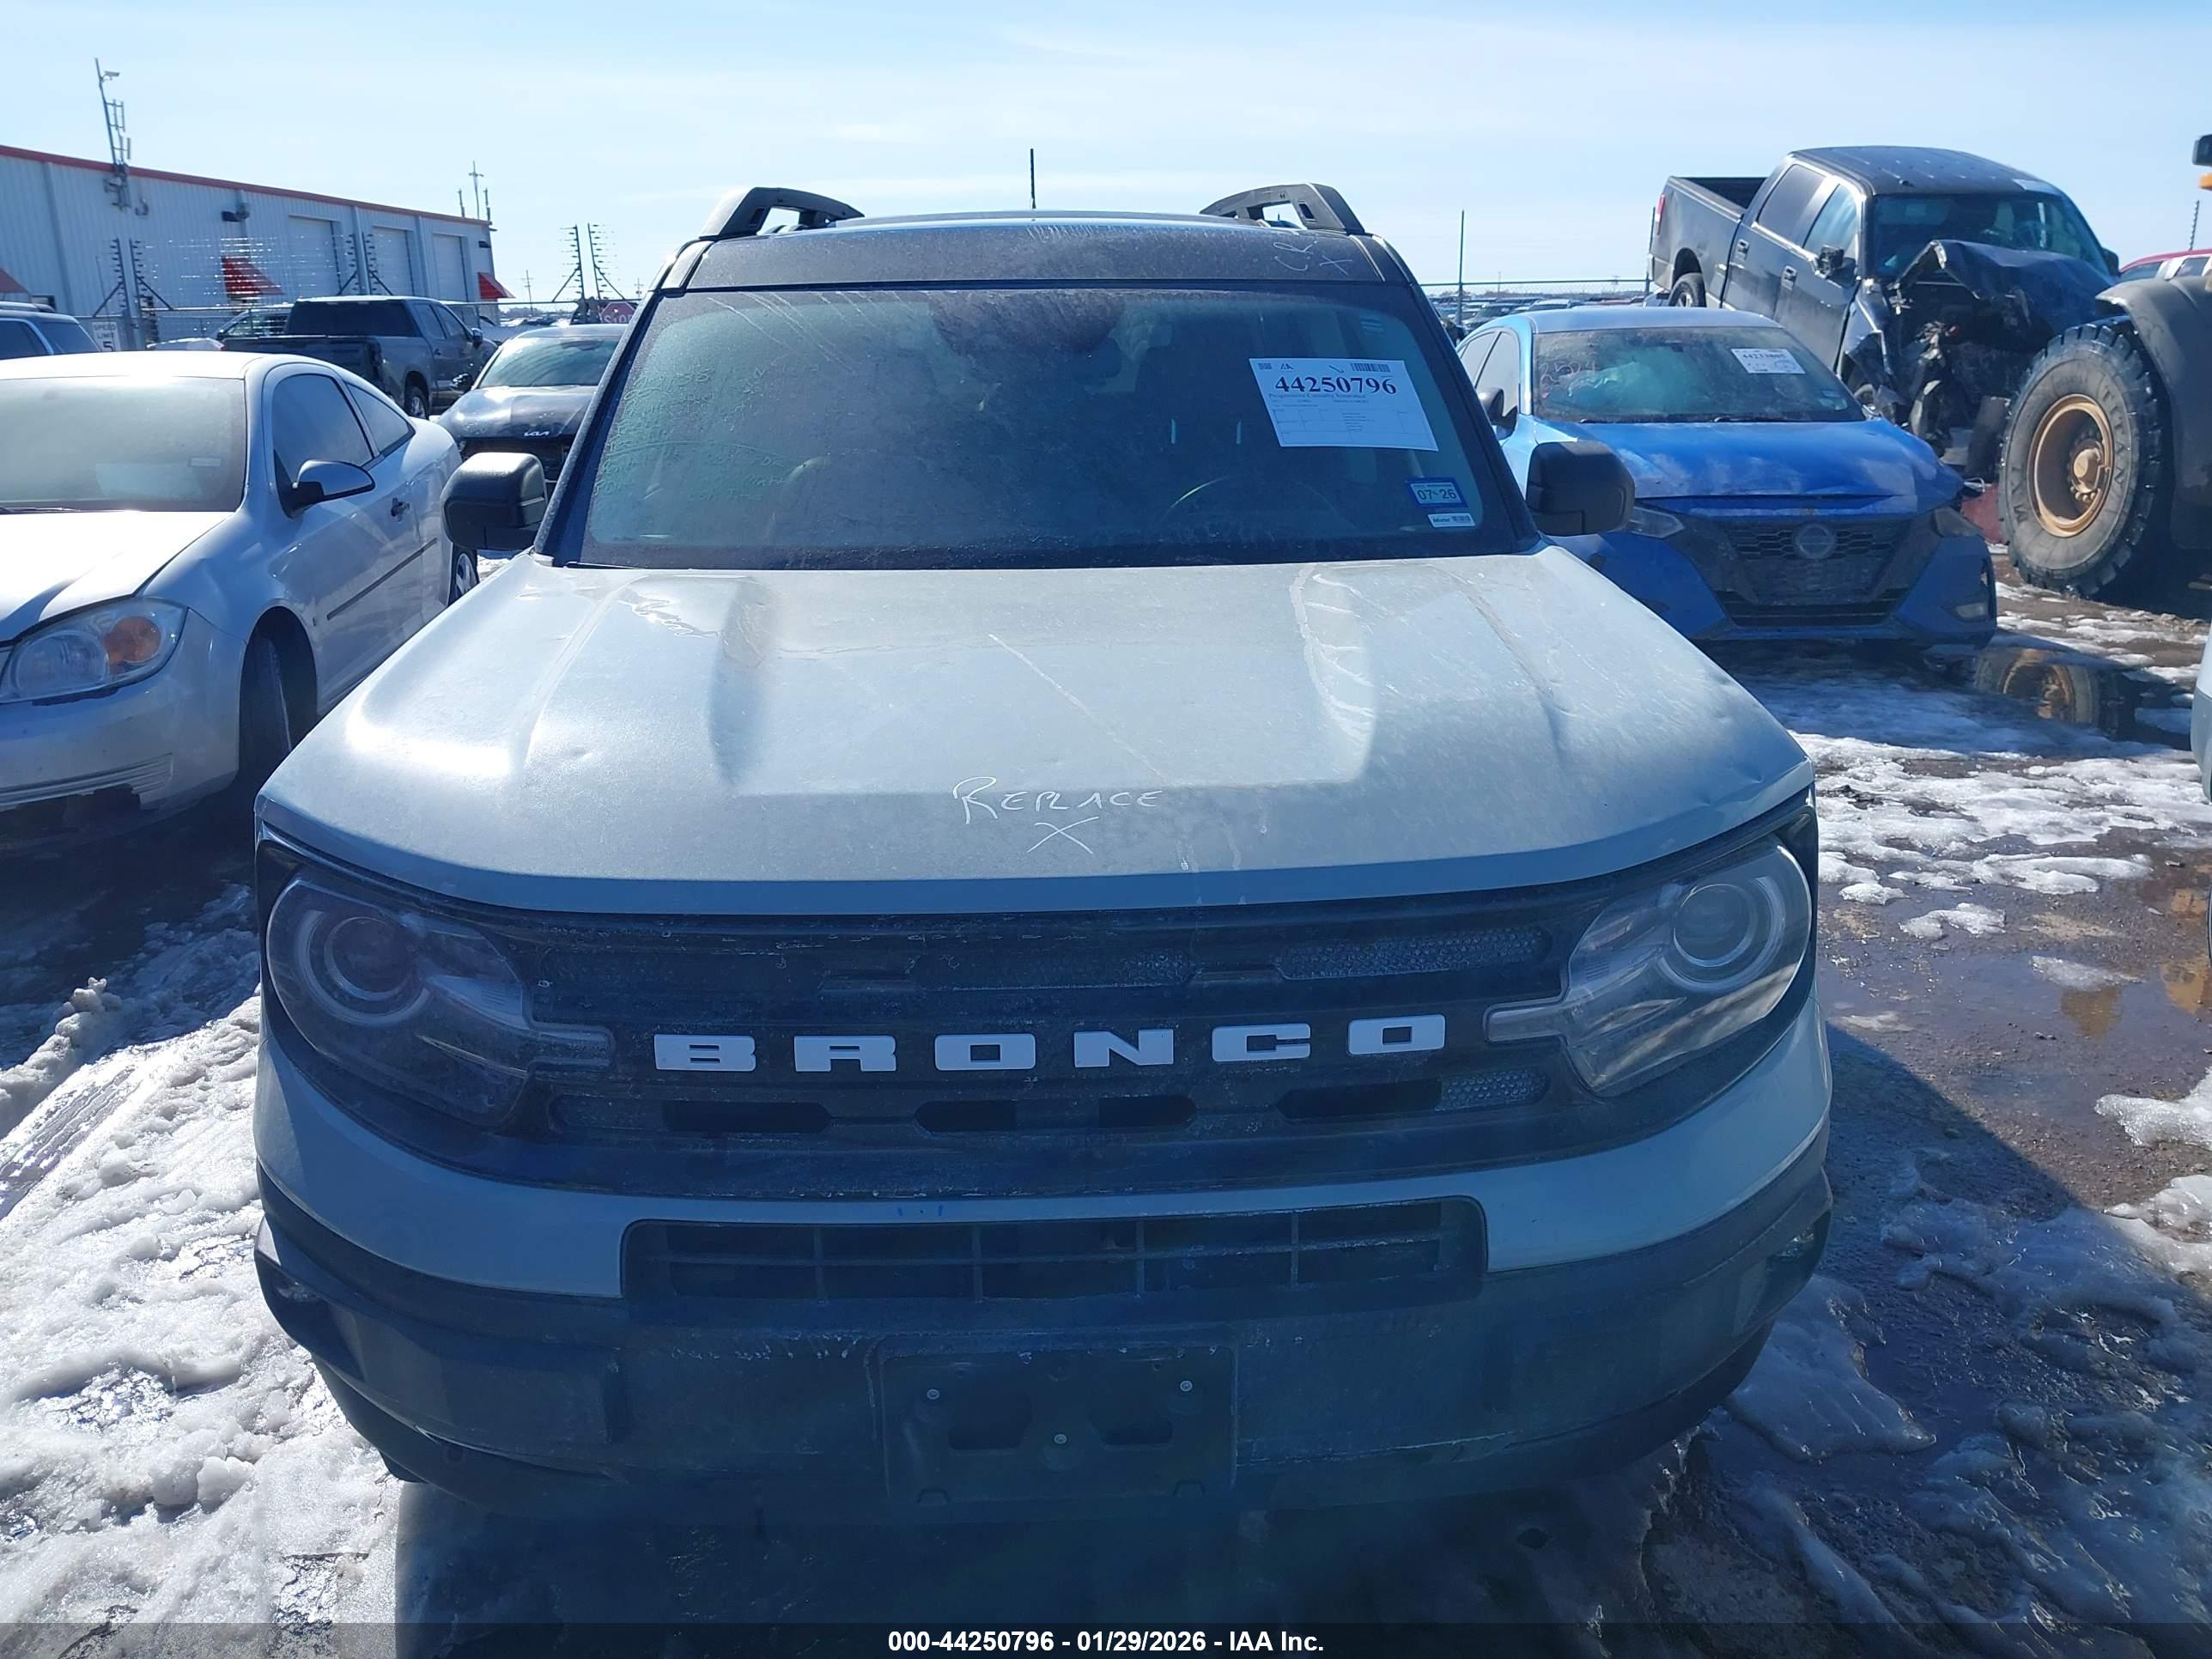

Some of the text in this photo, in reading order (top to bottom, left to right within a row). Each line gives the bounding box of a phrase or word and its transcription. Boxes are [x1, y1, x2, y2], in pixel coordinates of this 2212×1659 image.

[1275, 376, 1397, 394] 44250796
[1417, 489, 1456, 500] 07 26
[654, 1014, 1446, 1073] BRONCO
